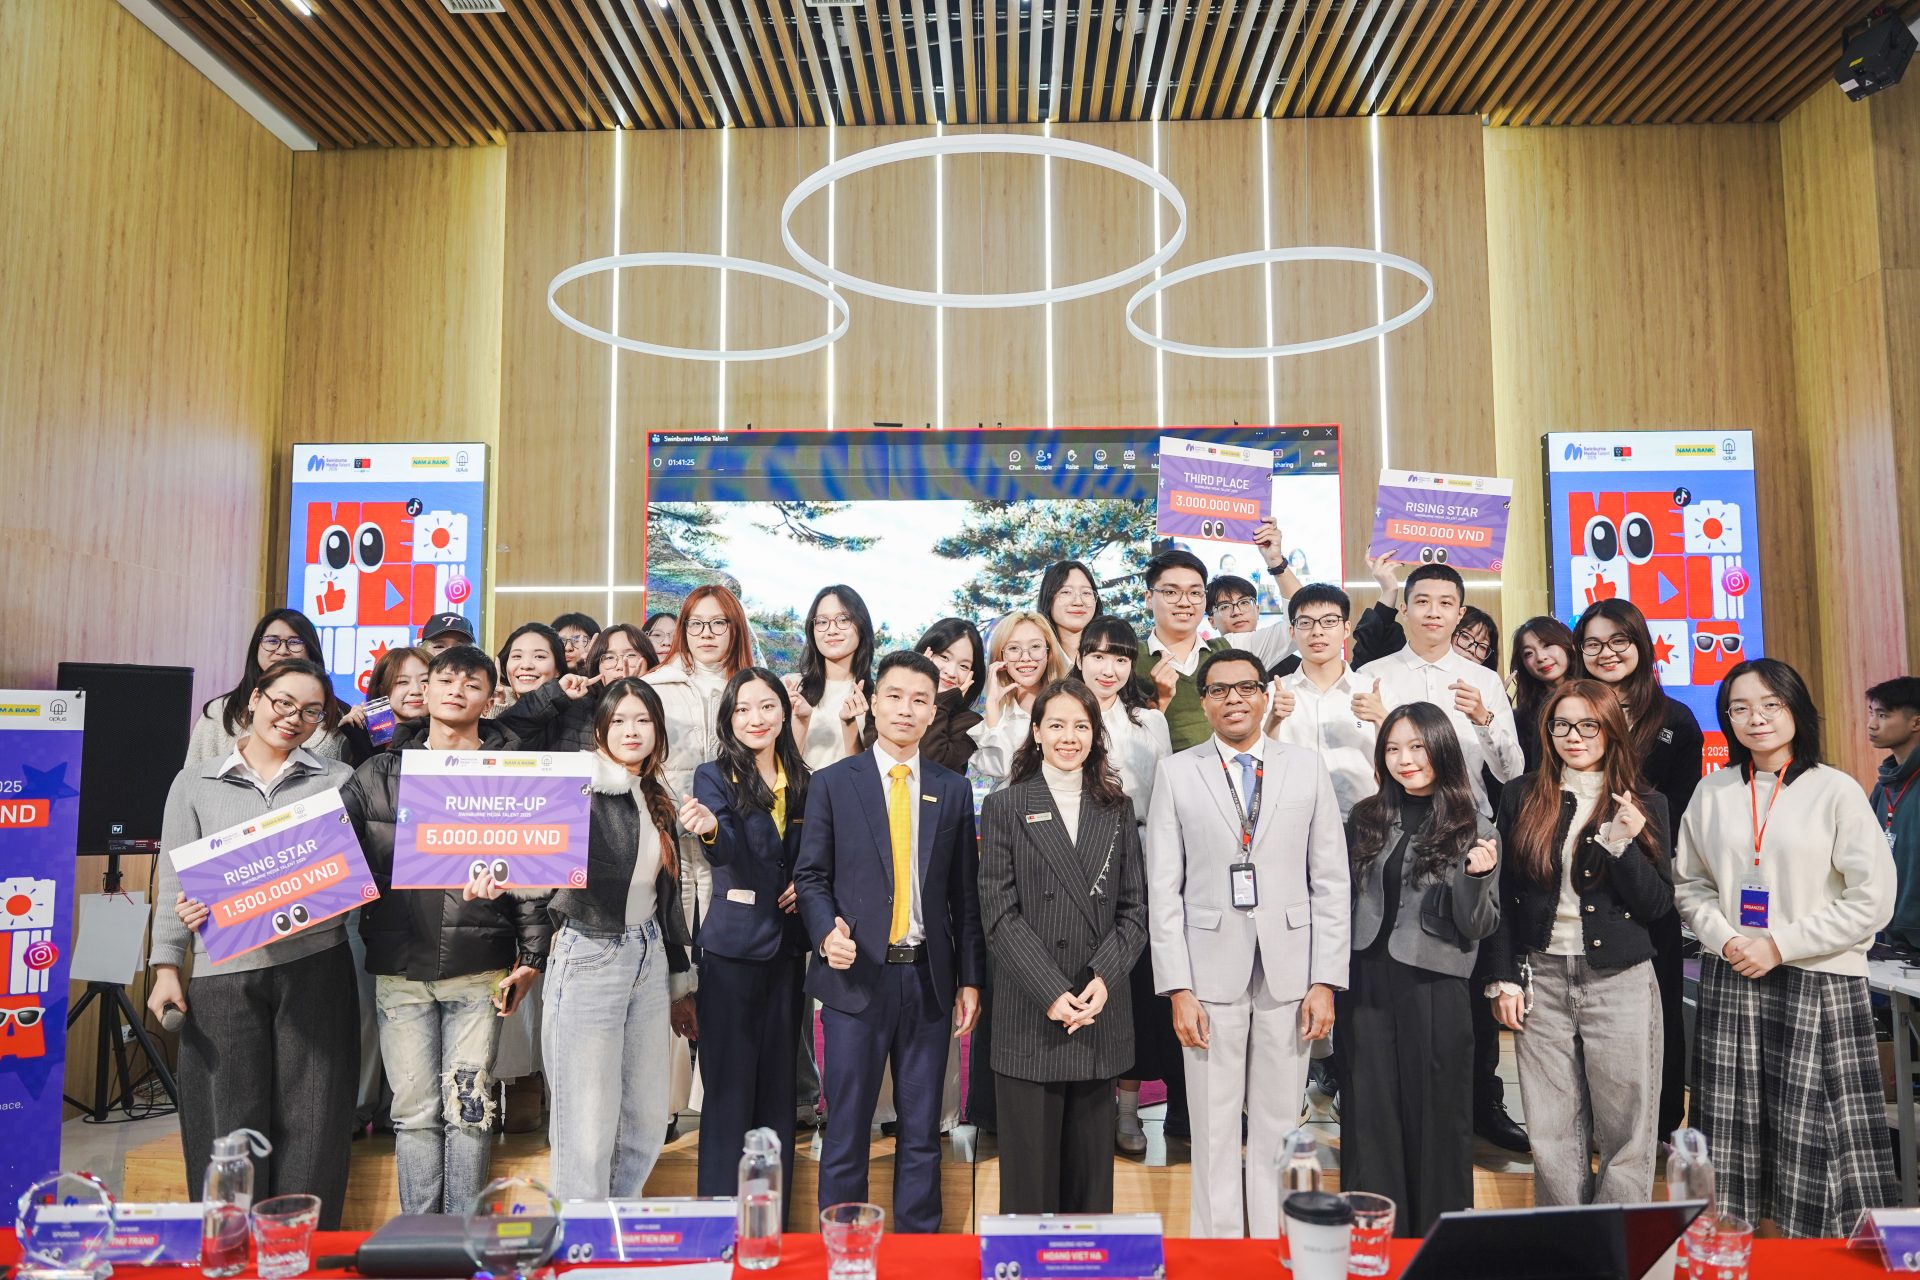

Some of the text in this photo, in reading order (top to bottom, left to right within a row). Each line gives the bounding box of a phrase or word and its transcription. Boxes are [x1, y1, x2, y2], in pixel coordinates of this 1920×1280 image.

[1275, 461, 1294, 469] sharing
[1184, 472, 1214, 485] THIRD
[1216, 476, 1250, 490] PLACE
[1176, 495, 1255, 515] 3.000.000 VND
[1405, 502, 1478, 518] RISING STAR
[1394, 523, 1484, 541] 1.500.000 VND
[1708, 746, 1729, 757] 2025
[445, 796, 547, 811] RUNNER-UP
[426, 829, 560, 846] 5.000.000 VND
[223, 839, 318, 886] RISING STAR
[222, 862, 339, 919] 1.500.000 VND
